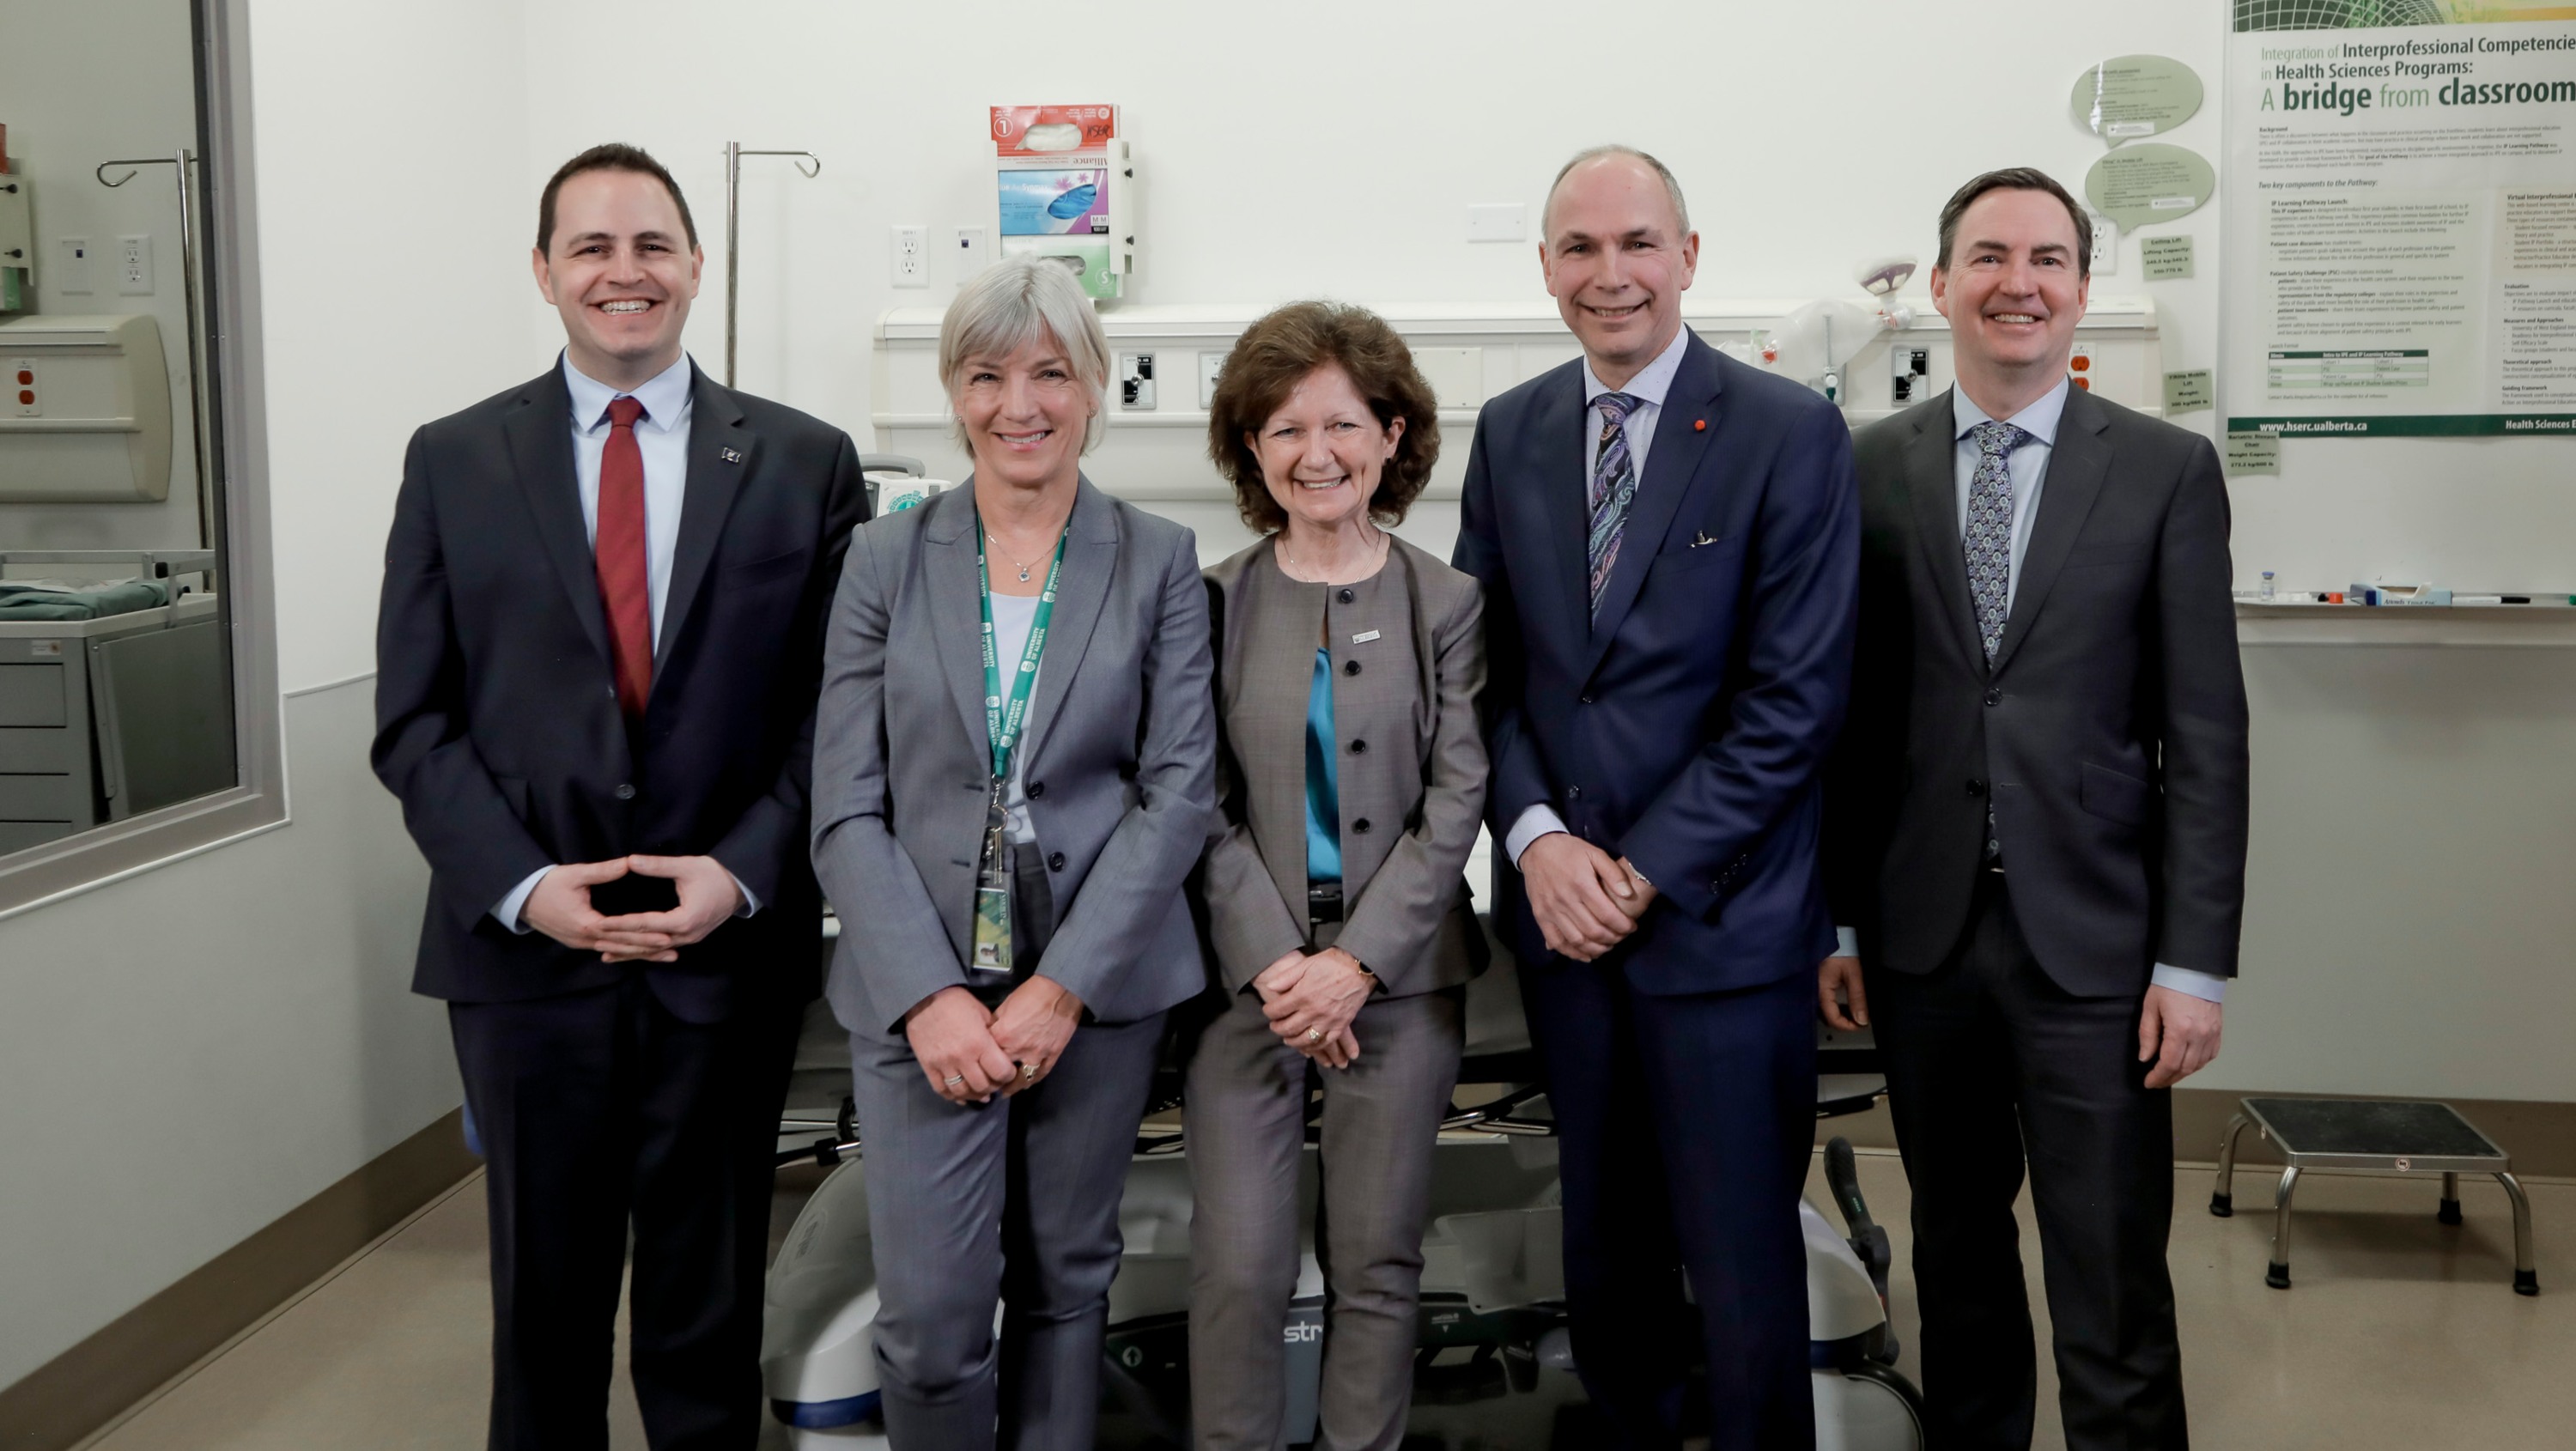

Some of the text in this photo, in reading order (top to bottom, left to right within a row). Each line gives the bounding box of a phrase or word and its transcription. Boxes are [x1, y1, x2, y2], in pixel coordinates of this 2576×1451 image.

[2262, 35, 2576, 62] Integration of Interprofessional Competencie
[2261, 60, 2473, 80] in Health Sciences Programs:
[2262, 78, 2576, 116] A bridge from classroom
[2259, 421, 2367, 432] www.hserc.ualberta.ca
[2506, 420, 2534, 429] Health
[2535, 419, 2570, 429] Sciences
[1048, 560, 1060, 590] UNIVERSITY
[987, 634, 995, 667] UNIVERSITY
[1025, 627, 1039, 659] UNIVERSITY
[1033, 629, 1045, 652] ALBERTA
[1004, 699, 1017, 733] UNIVERSITY
[1013, 700, 1024, 727] ALBERTA
[1284, 1321, 1323, 1343] str
